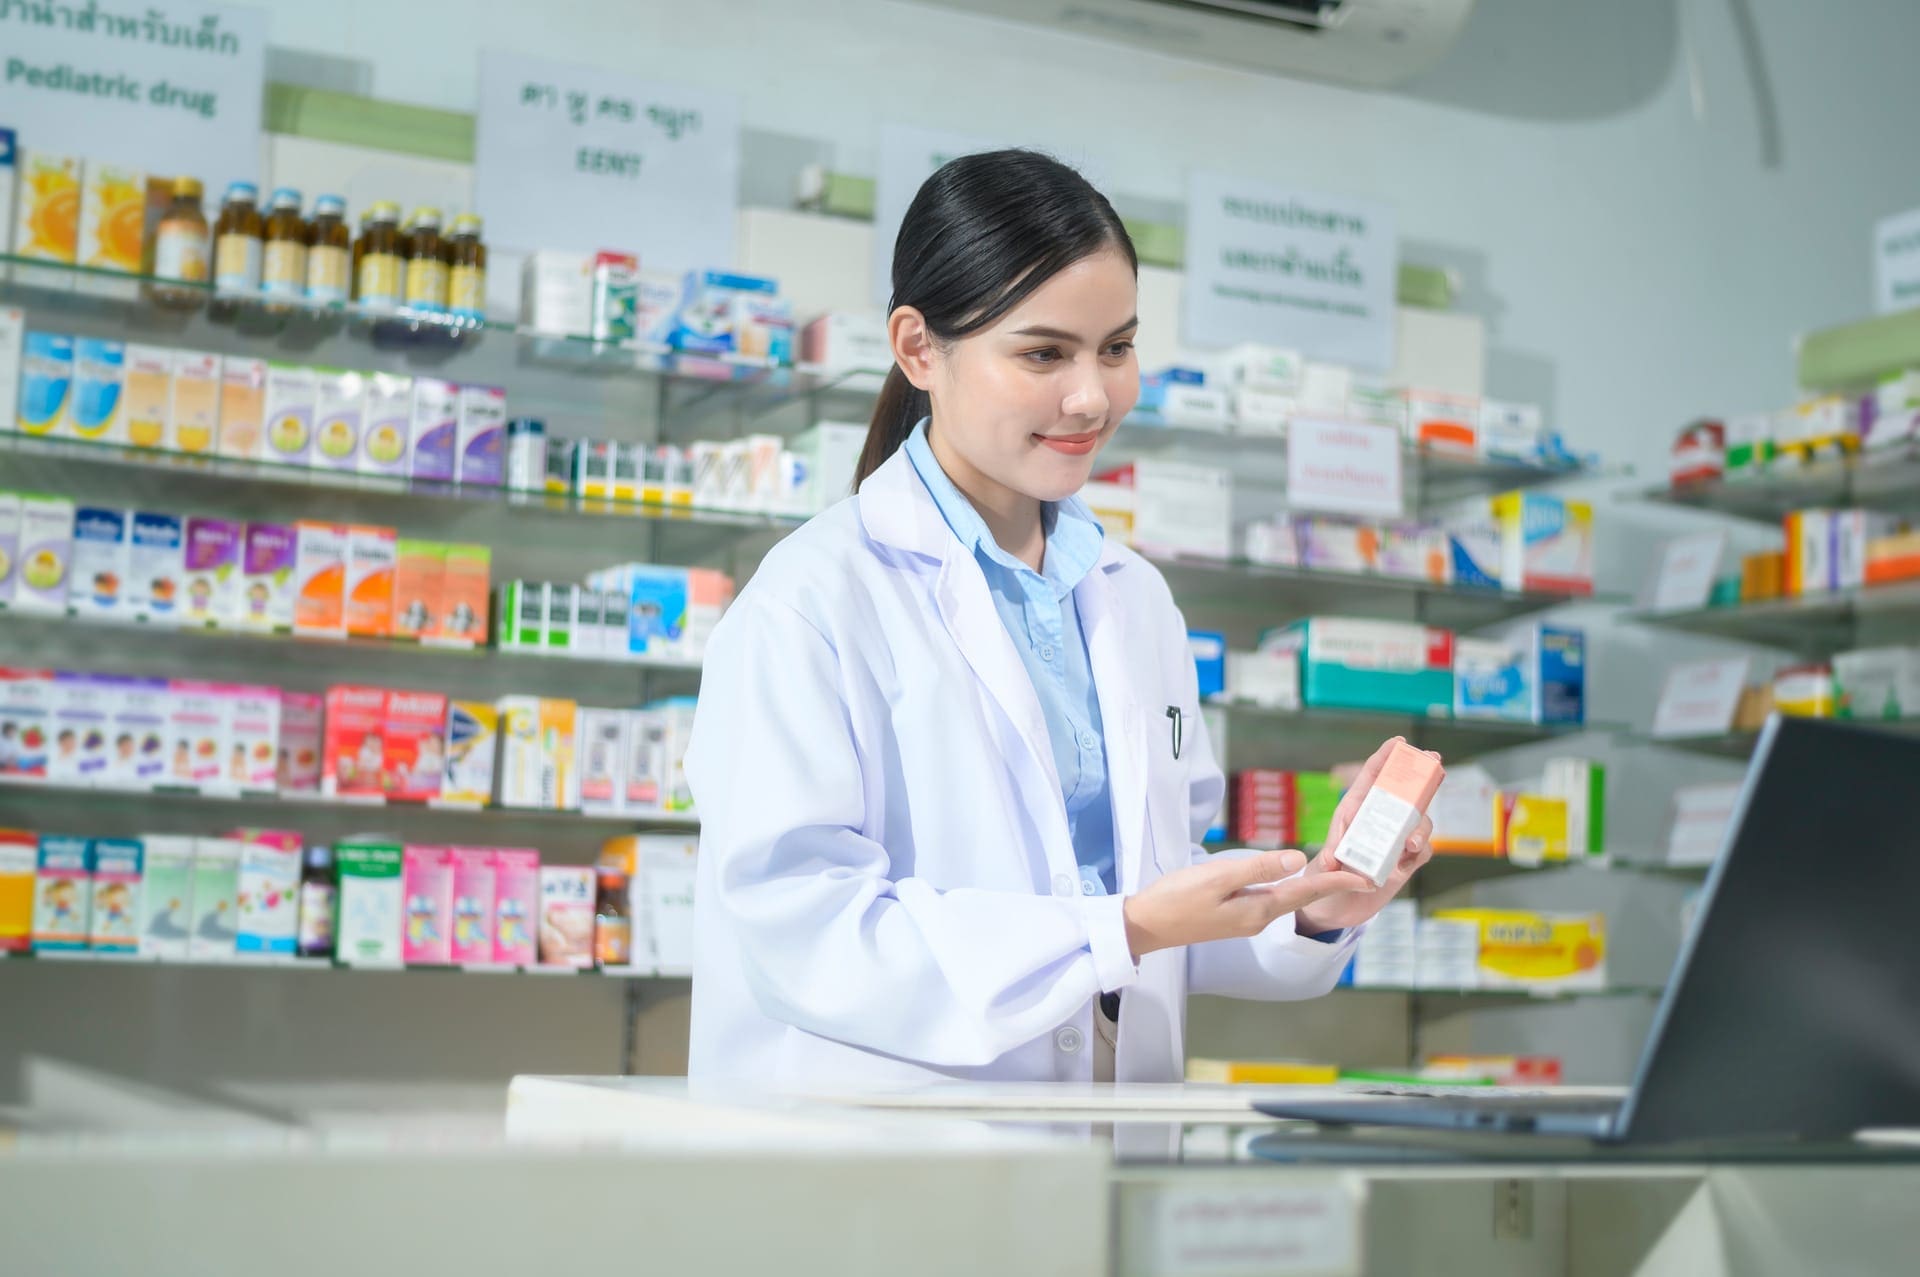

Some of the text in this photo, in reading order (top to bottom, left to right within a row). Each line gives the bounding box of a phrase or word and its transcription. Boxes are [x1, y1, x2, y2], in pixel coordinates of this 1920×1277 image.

[0, 0, 239, 54] านำสำหรับเด็ก
[6, 57, 217, 119] Pediatric drug
[576, 147, 641, 178] EENT
